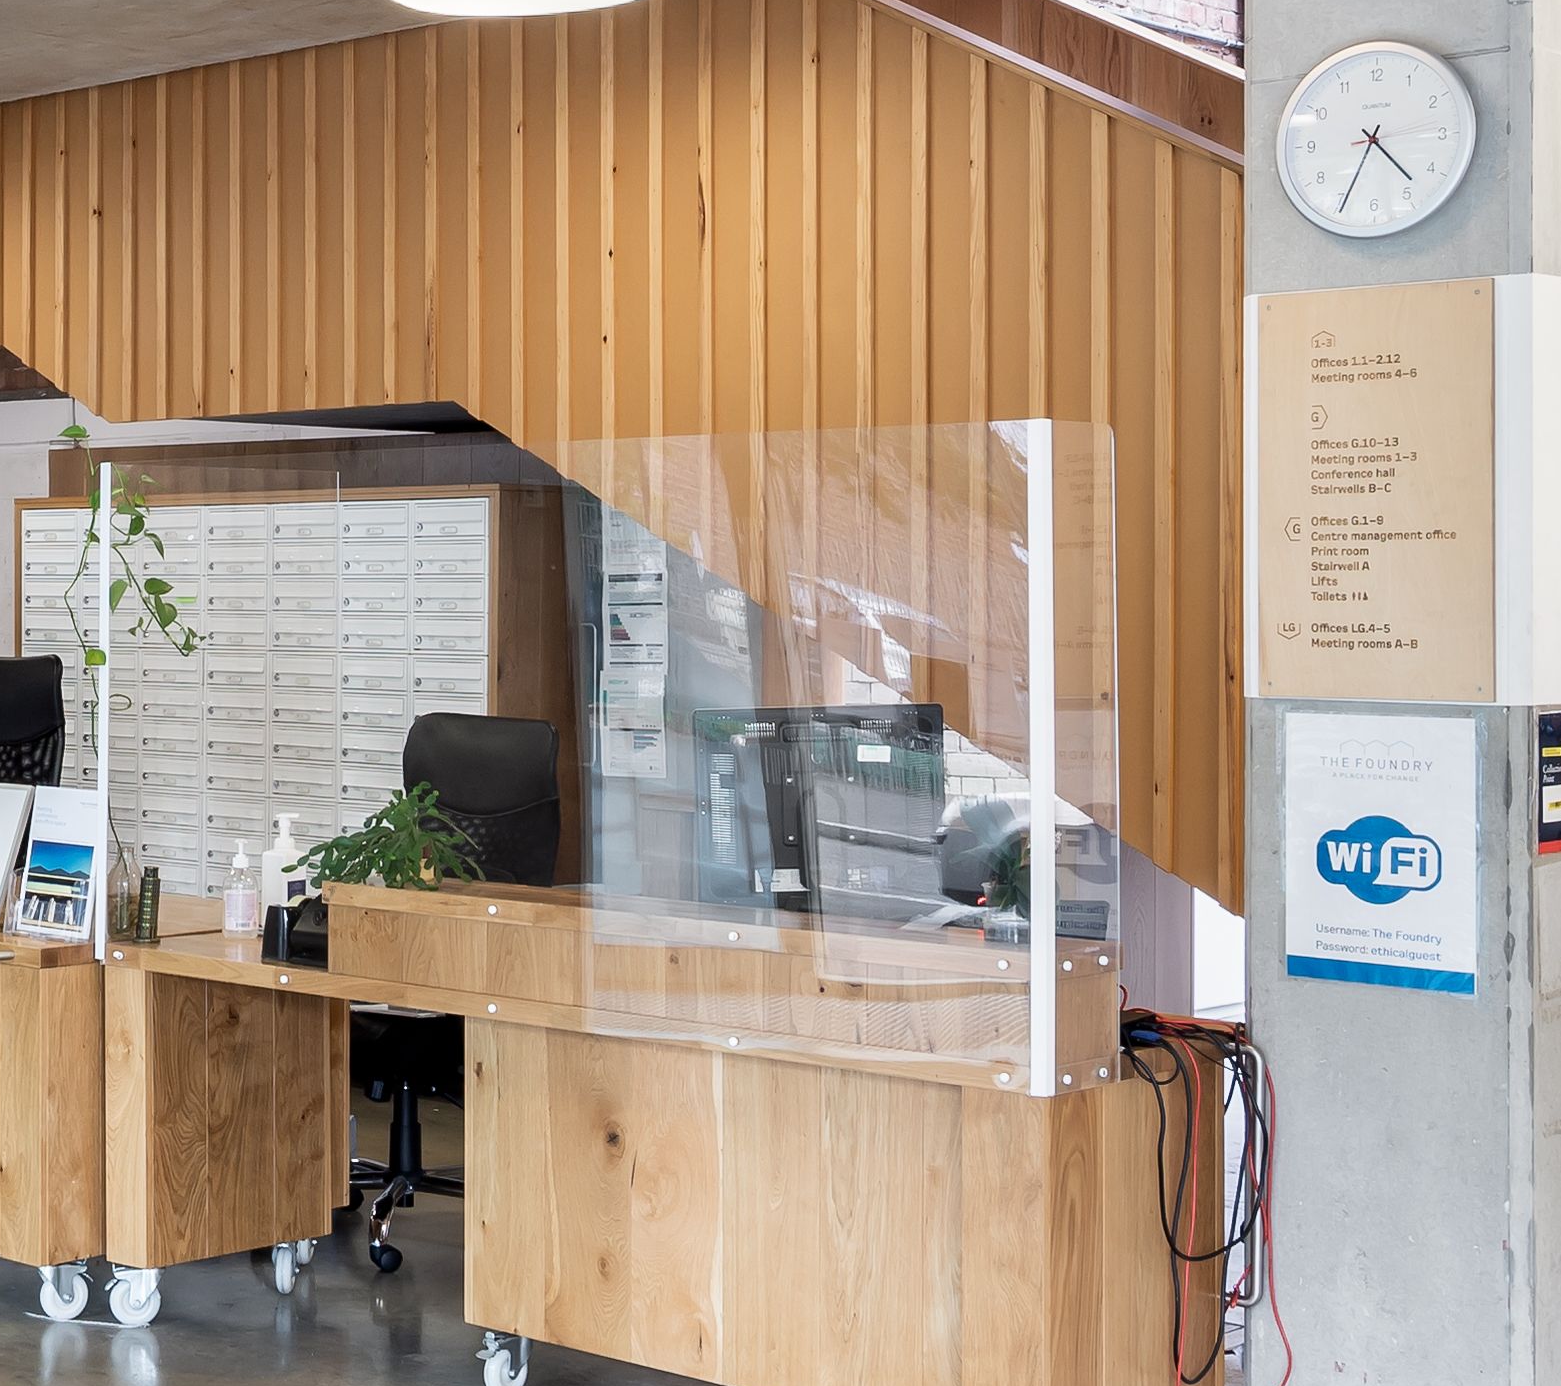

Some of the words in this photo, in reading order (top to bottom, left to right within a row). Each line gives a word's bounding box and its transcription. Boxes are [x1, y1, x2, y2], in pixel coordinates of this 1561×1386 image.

[1370, 68, 1384, 82] 12
[1406, 75, 1412, 87] 1
[1339, 82, 1350, 94] 11
[1362, 102, 1391, 110] QUANTUM
[1428, 95, 1438, 109] 2
[1315, 107, 1328, 120] 10
[1438, 127, 1447, 141] 3
[1307, 141, 1316, 153] 9
[1426, 162, 1435, 173] 4
[1316, 171, 1325, 184] 8
[1402, 186, 1412, 200] 5
[1337, 193, 1345, 206] 7
[1369, 199, 1379, 211] 6
[1311, 358, 1348, 368] Offices
[1311, 373, 1355, 384] Meeting
[1357, 371, 1392, 381] rooms
[1311, 412, 1319, 423] G
[1311, 440, 1348, 450] Offices
[1311, 454, 1355, 465] Meeting
[1357, 453, 1392, 463] rooms
[1311, 469, 1373, 480] Conference
[1376, 468, 1395, 478] hall
[1311, 484, 1365, 495] Stairwells
[1311, 516, 1348, 526] Offices
[1293, 524, 1301, 534] G
[1311, 532, 1348, 541] Centre
[1351, 531, 1423, 542] management
[1426, 529, 1457, 540] office
[1311, 546, 1339, 556] Print
[1341, 548, 1369, 556] room
[1311, 561, 1359, 571] Stairwell
[1362, 561, 1370, 571] A
[1311, 576, 1338, 586] Lifts
[1311, 591, 1347, 601] Toilets
[1283, 623, 1296, 632] LG
[1311, 623, 1348, 633] Offices
[1312, 638, 1355, 650] Meeting
[1358, 639, 1392, 649] rooms
[1320, 756, 1349, 768] THE
[1355, 758, 1433, 771] FOUNDRY
[1386, 774, 1419, 782] CHANGE
[1316, 923, 1370, 938] Username:
[1373, 928, 1392, 939] The
[1396, 930, 1442, 946] Foundry
[1316, 940, 1368, 954] Password:
[1371, 947, 1442, 962] ethicalguest
